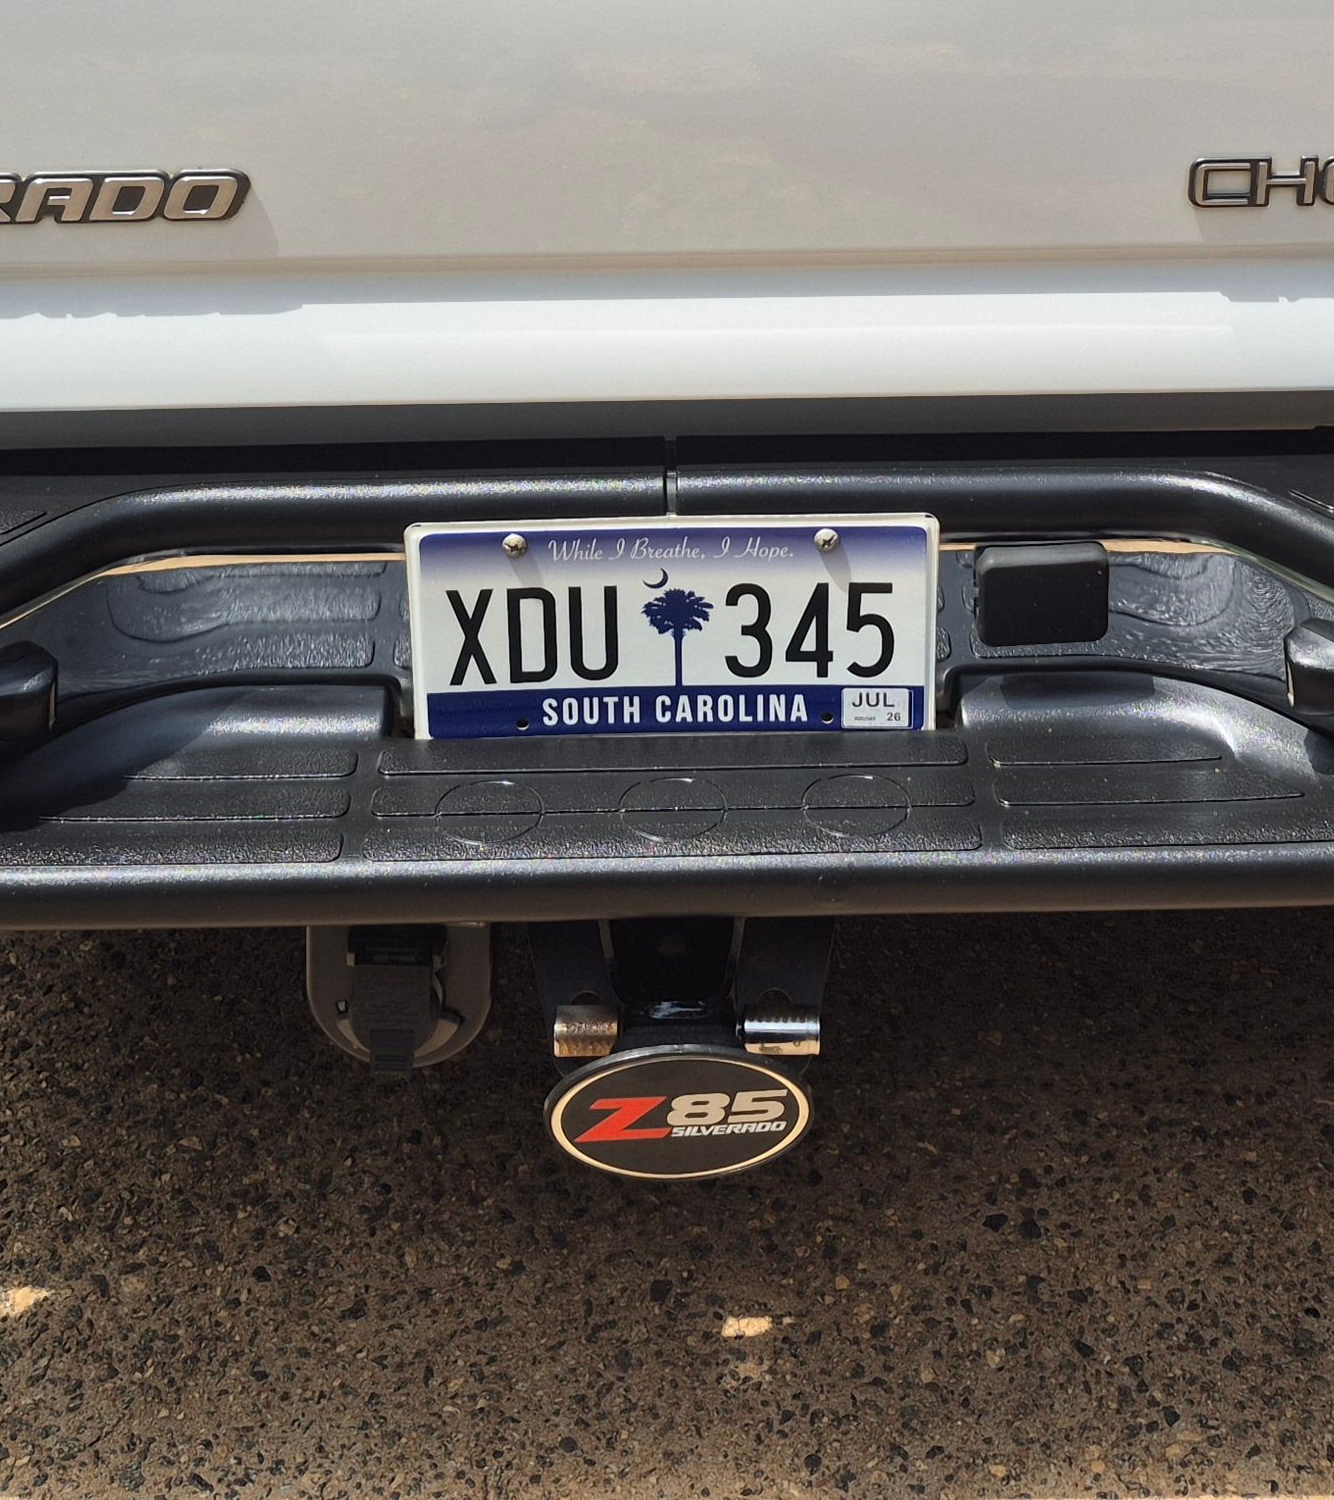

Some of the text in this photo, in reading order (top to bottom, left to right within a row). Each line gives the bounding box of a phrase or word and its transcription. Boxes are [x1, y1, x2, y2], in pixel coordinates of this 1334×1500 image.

[548, 536, 794, 562] While I Breathe, I Hope.
[445, 582, 895, 686] XDU 345
[542, 692, 808, 726] SOUTH CAROLINA
[852, 692, 895, 707] JUL
[886, 712, 901, 722] 26
[574, 1089, 788, 1142] Z85
[671, 1120, 787, 1138] SILVERADO
